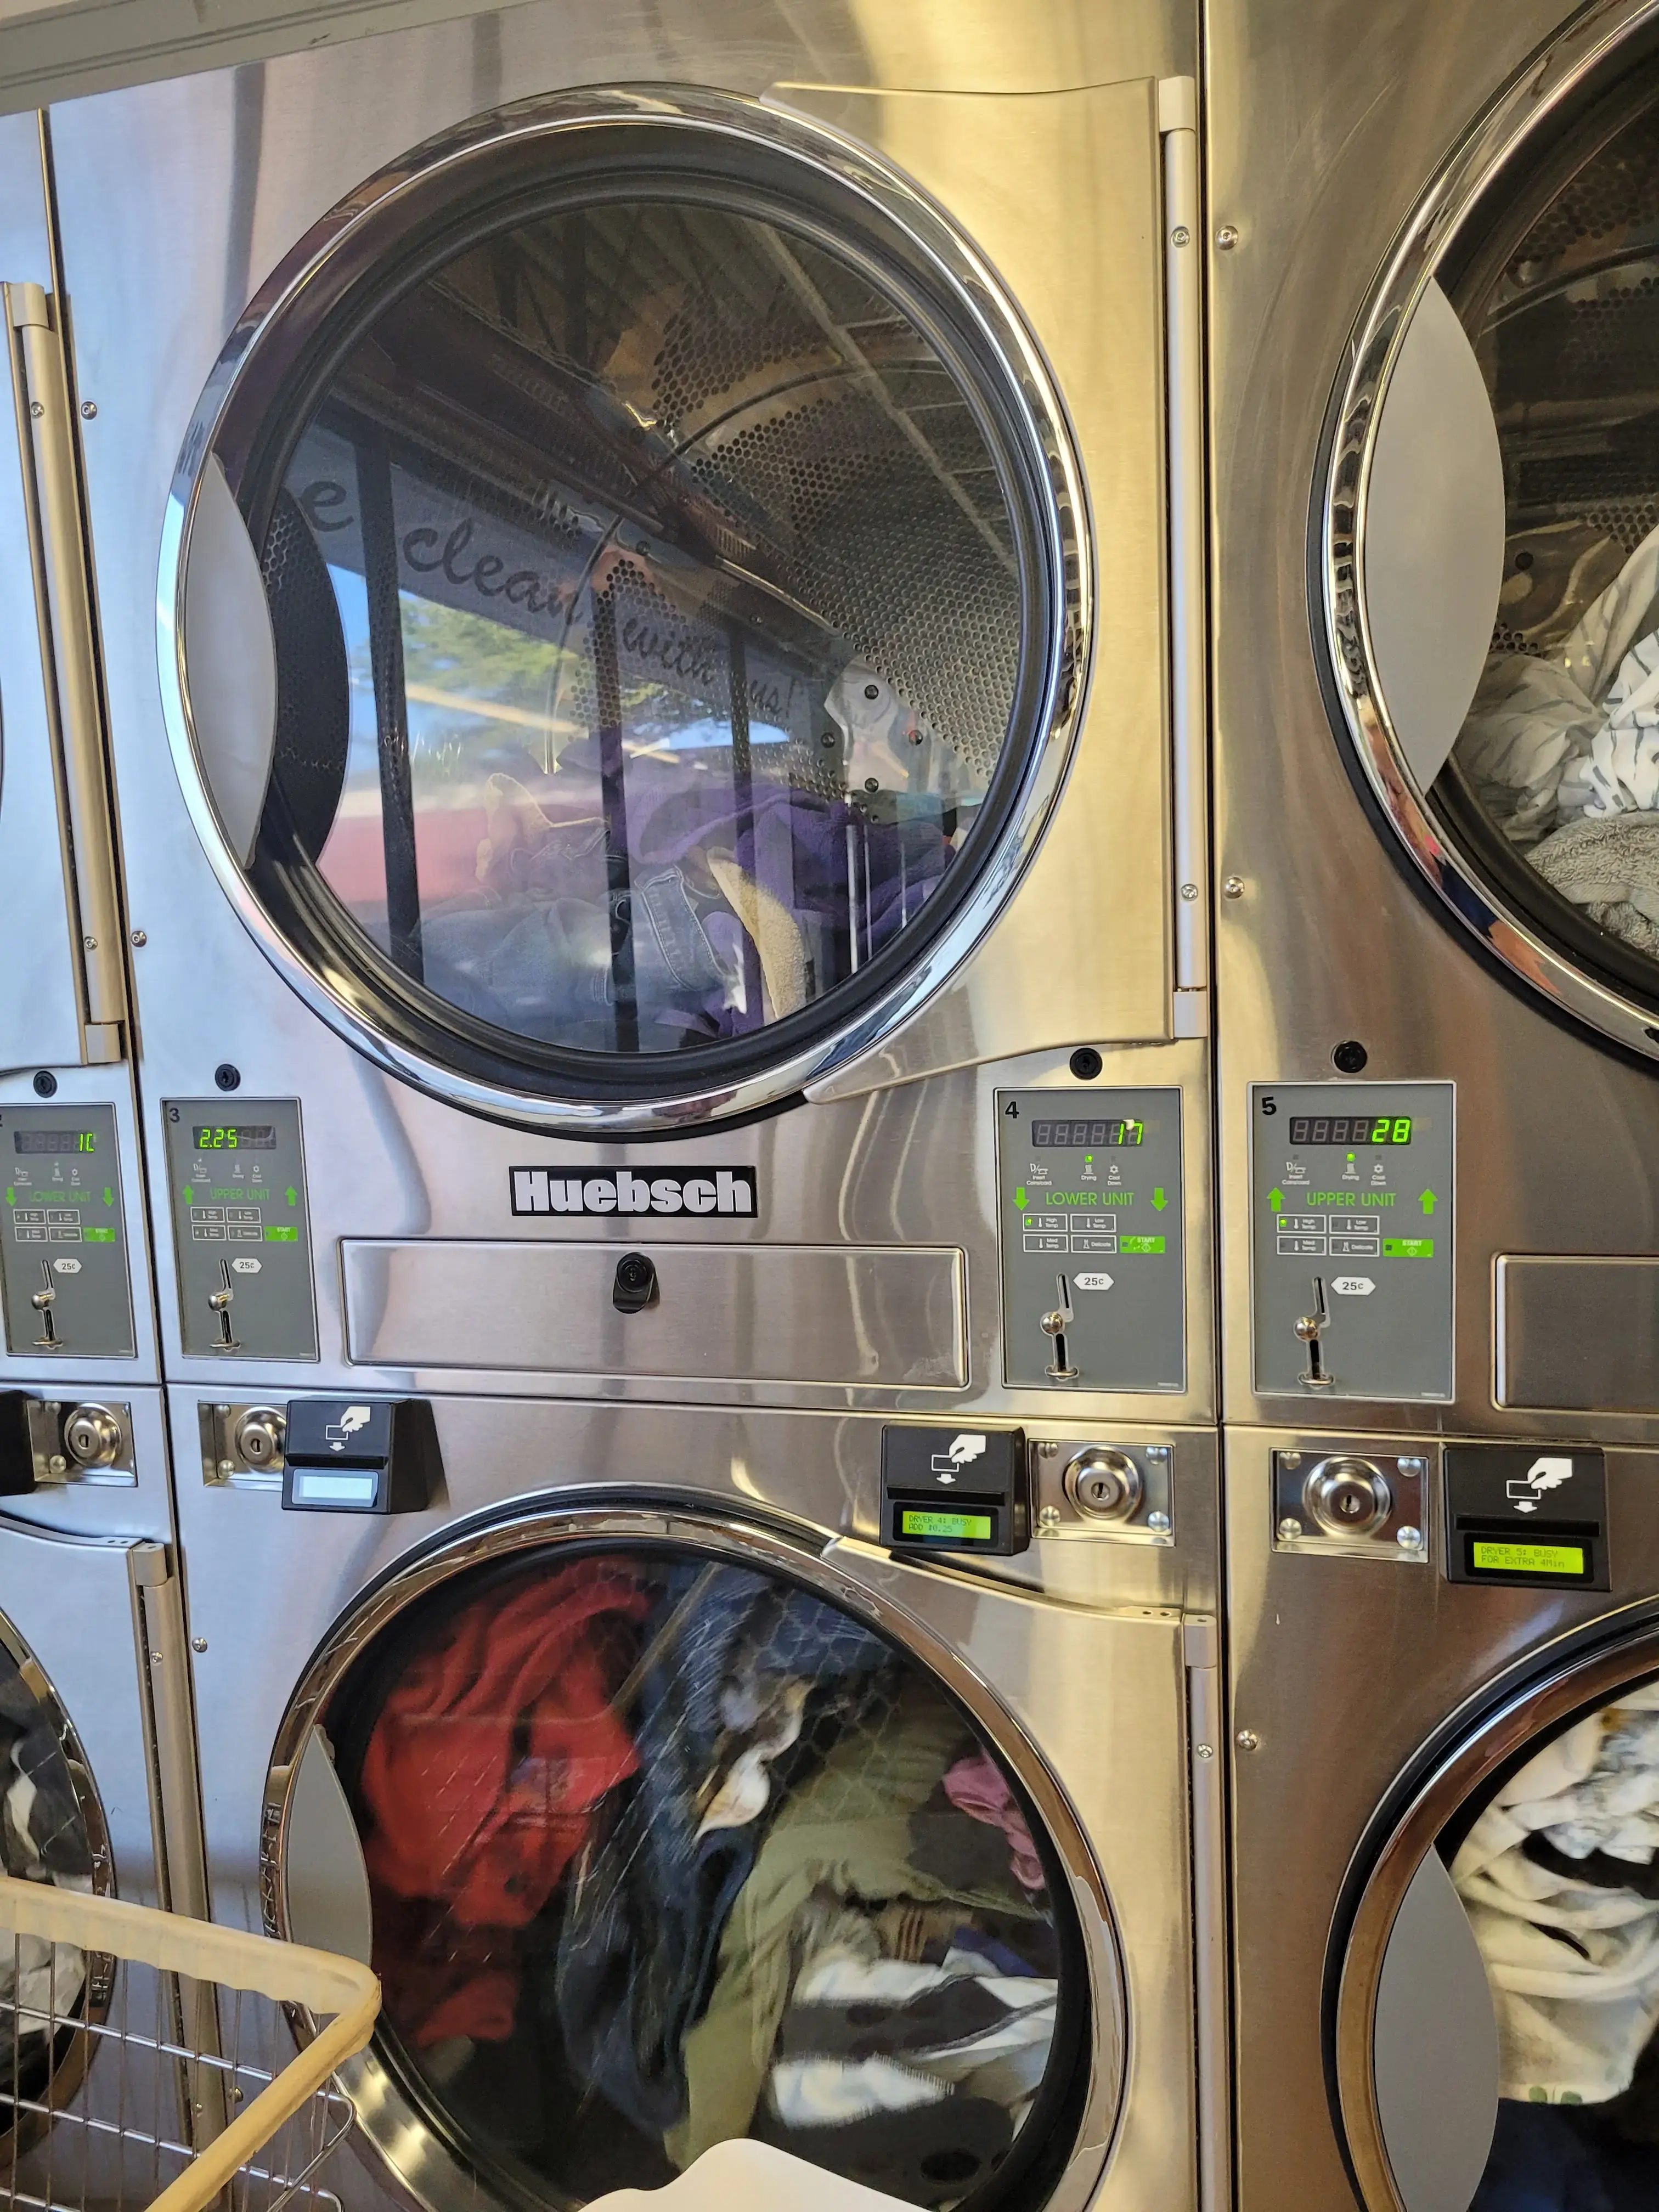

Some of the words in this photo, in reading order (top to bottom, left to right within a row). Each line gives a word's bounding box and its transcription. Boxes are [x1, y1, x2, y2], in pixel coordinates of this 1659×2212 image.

[1005, 1101, 1019, 1119] 4
[1262, 1096, 1277, 1115] 5
[170, 1108, 180, 1122] 3
[200, 1128, 238, 1148] 2.25
[1117, 1122, 1144, 1146] 17
[1372, 1119, 1411, 1143] 28
[30, 1191, 65, 1203] LOWER
[69, 1191, 91, 1203] UNIT
[209, 1188, 244, 1200] UPPER
[247, 1188, 270, 1200] UNIT
[514, 1170, 752, 1213] Huebsch
[1046, 1192, 1097, 1205] LOWER
[1102, 1192, 1135, 1205] UNIT
[1307, 1192, 1355, 1206] UPPER
[1361, 1193, 1397, 1206] UNIT
[909, 1515, 933, 1523] DRYER
[951, 1517, 972, 1526] BUSY
[1481, 1546, 1510, 1555] DRYER
[1534, 1549, 1558, 1558] BUSY
[1481, 1555, 1499, 1564] FOR
[1505, 1557, 1535, 1565] EXTRA
